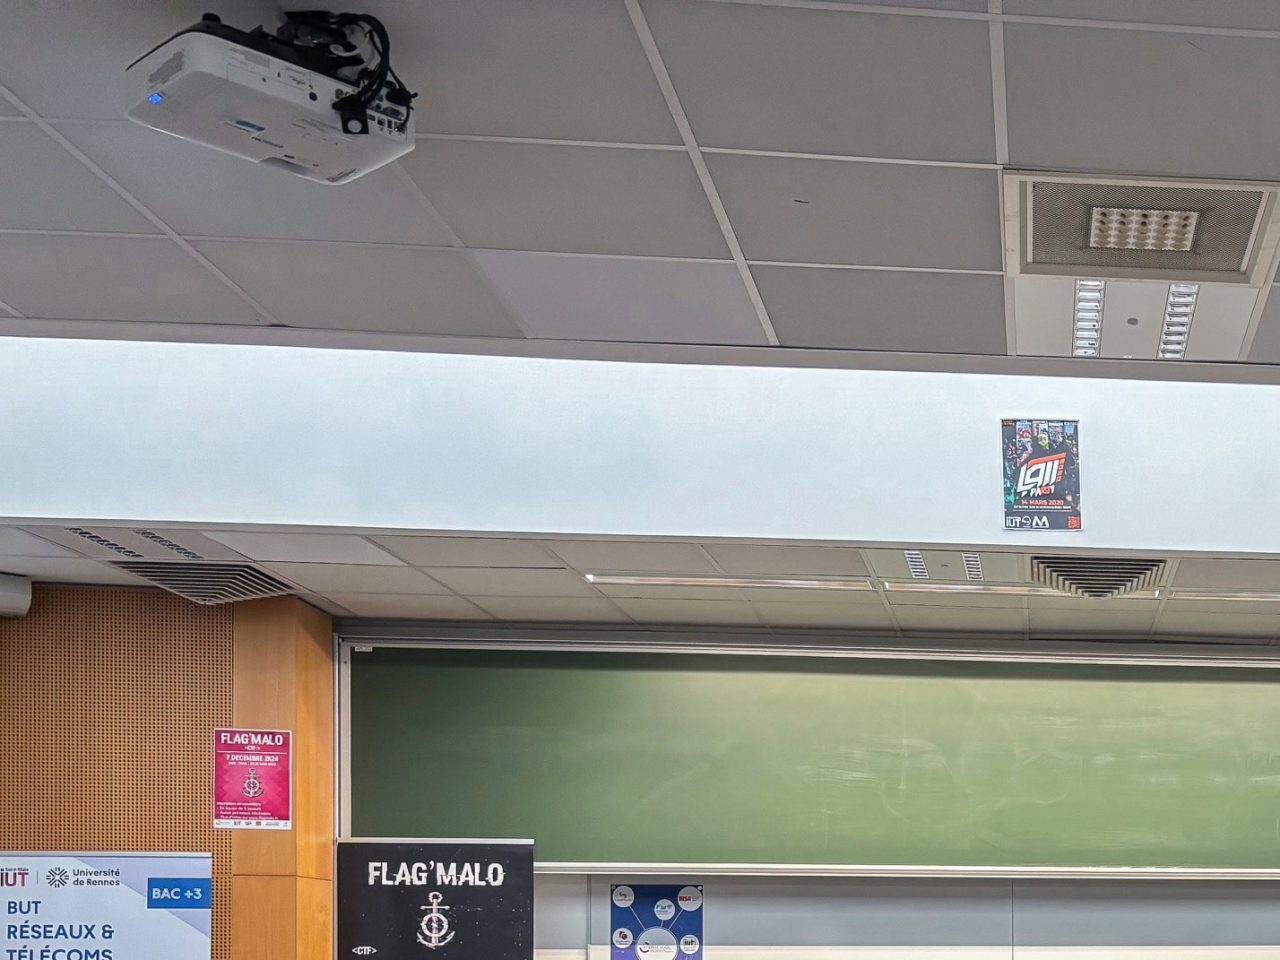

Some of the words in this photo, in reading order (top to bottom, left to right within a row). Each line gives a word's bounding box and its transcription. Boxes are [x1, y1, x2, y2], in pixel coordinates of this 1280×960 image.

[221, 733, 283, 746] FLAG'MALO
[73, 868, 120, 877] Université
[368, 860, 506, 887] FLAG'MALO
[73, 878, 85, 886] de
[86, 879, 120, 887] Rennes
[152, 888, 181, 900] BAC
[184, 888, 202, 899] +3
[7, 901, 41, 915] BUT
[7, 920, 95, 939] RÉSEAUX
[101, 924, 114, 939] &
[352, 946, 377, 955] <CTF>
